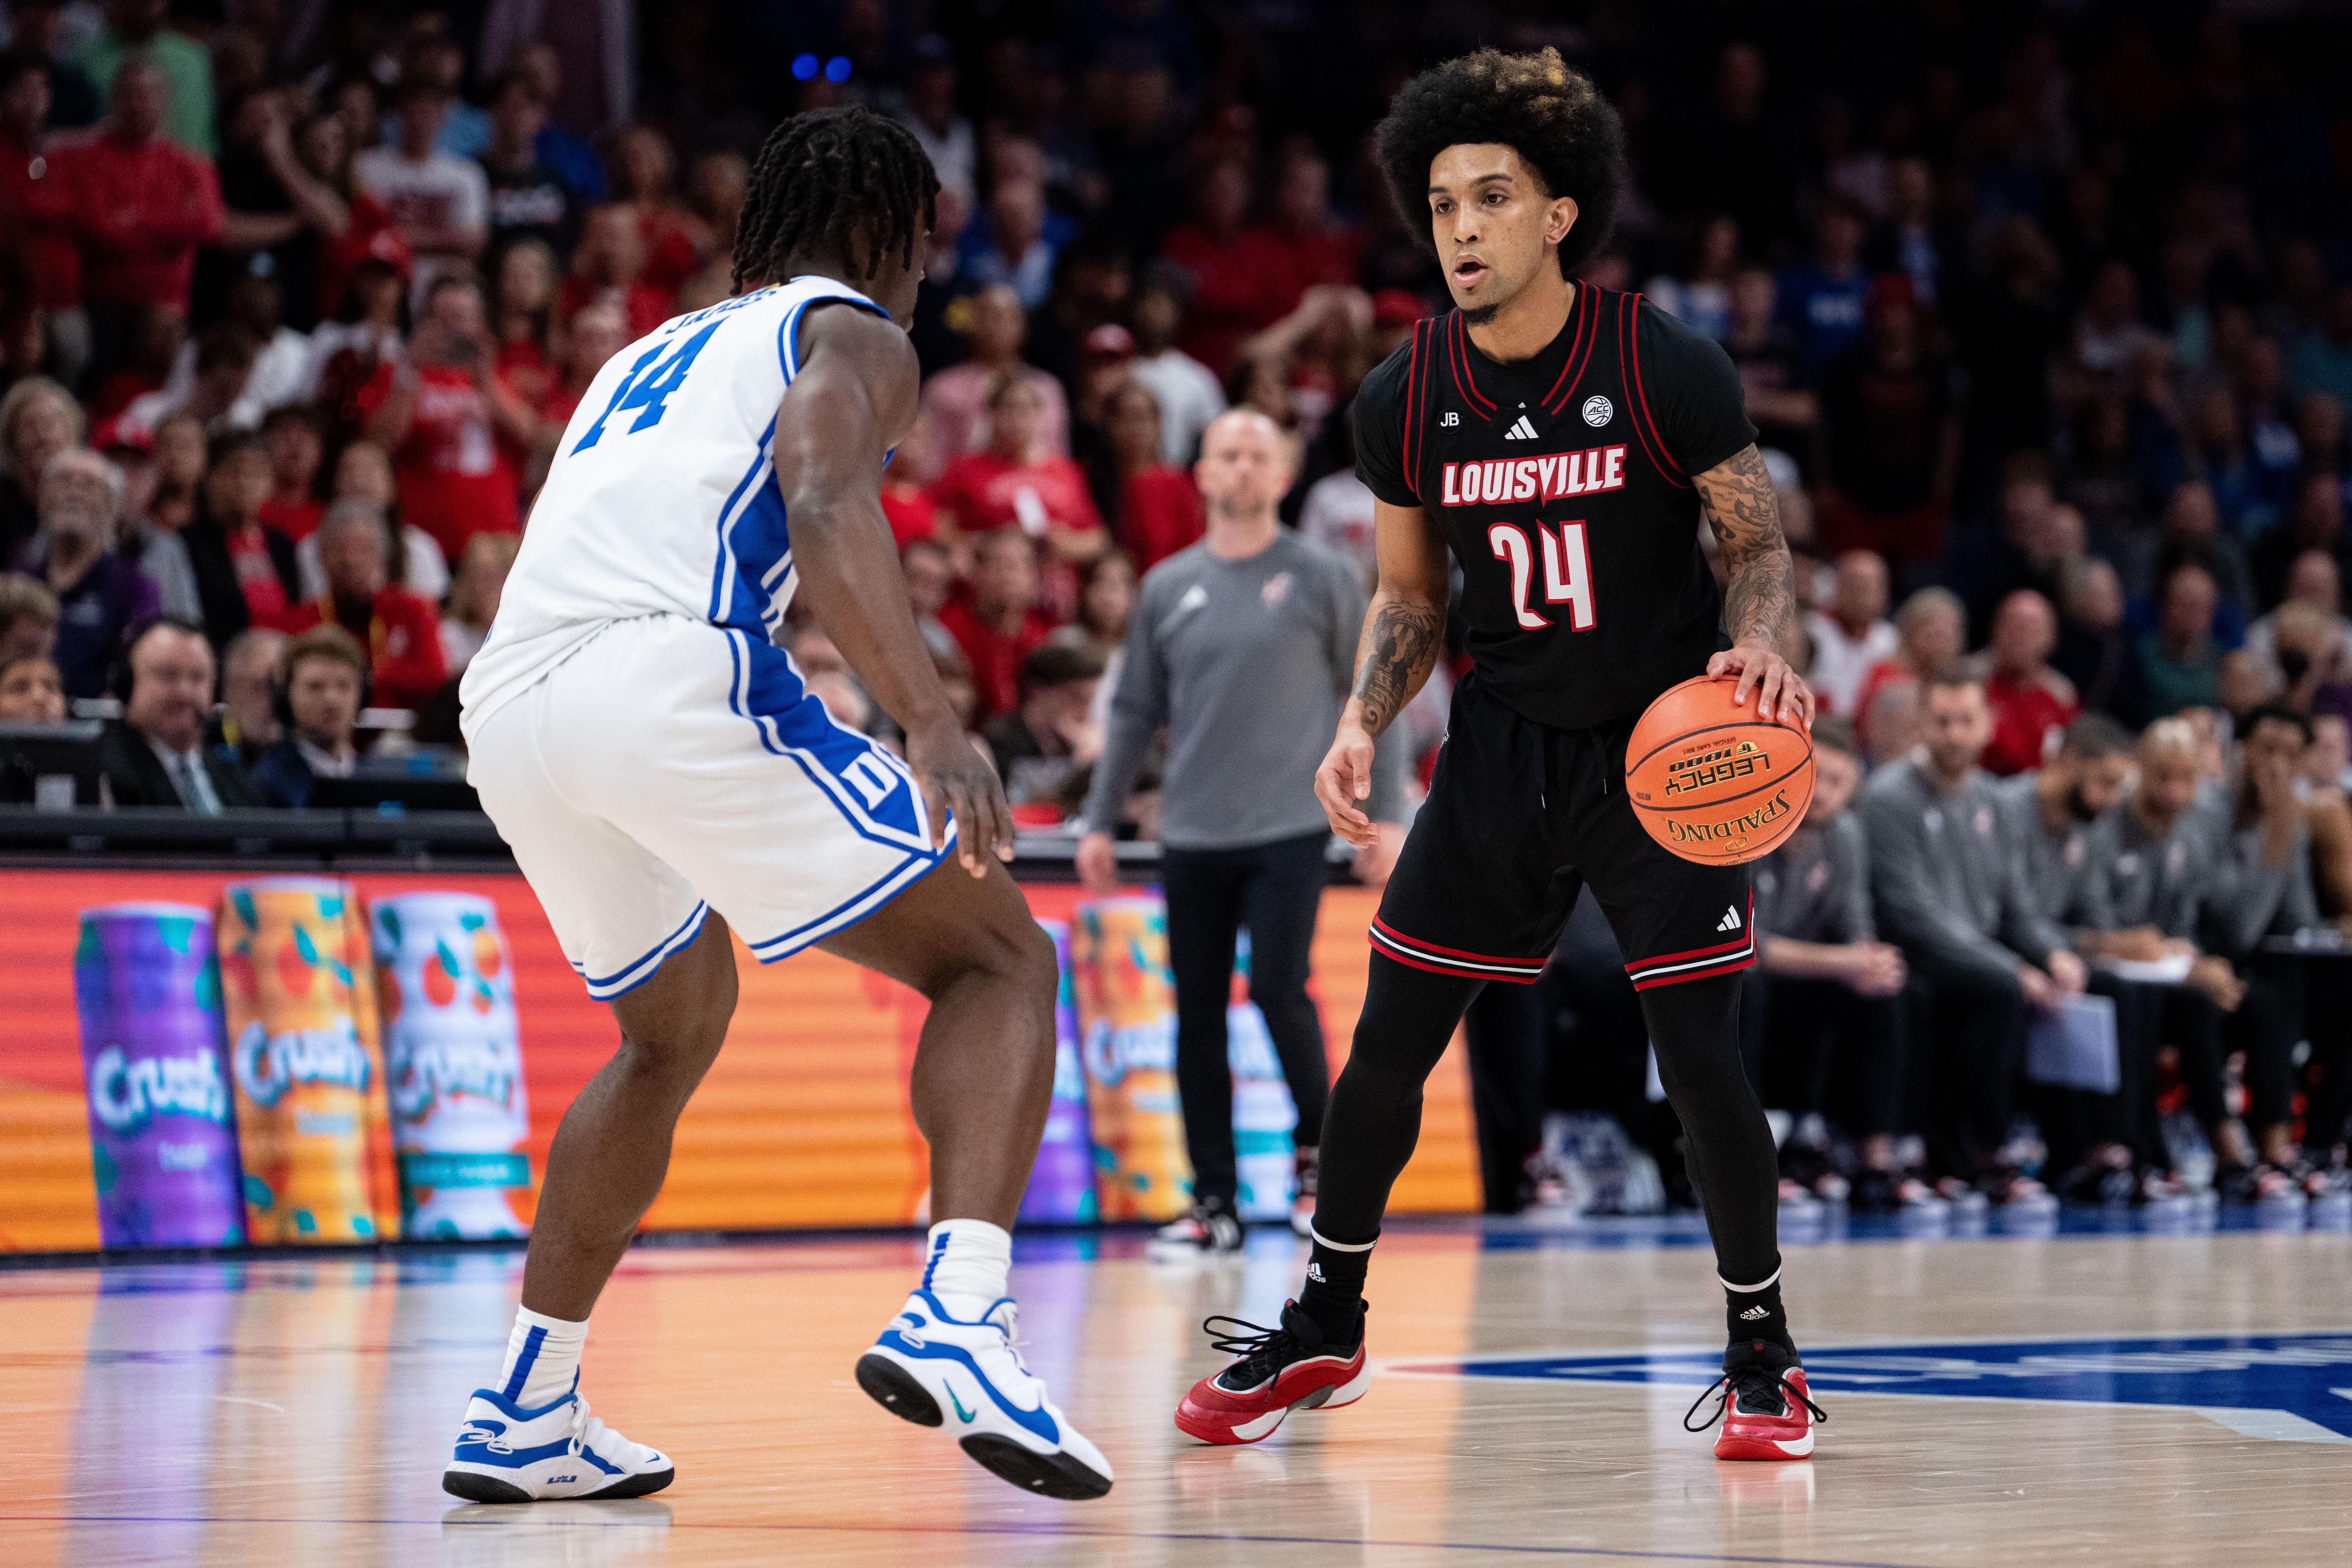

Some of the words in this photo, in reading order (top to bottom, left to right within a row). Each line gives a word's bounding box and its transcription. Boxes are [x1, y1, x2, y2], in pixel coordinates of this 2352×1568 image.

[569, 315, 731, 458] 14
[1440, 412, 1459, 427] JB
[1587, 404, 1610, 414] ACC
[1441, 443, 1627, 507] LOUISVILLE
[1487, 519, 1597, 633] 24
[1697, 743, 1711, 752] GAME
[1712, 736, 1737, 747] OFFICIAL
[1664, 751, 1771, 798] LEGACY
[1669, 747, 1733, 773] 1000
[1666, 787, 1791, 842] SPALDING
[391, 1025, 515, 1122] Cruh
[1740, 1311, 1770, 1320] adidas
